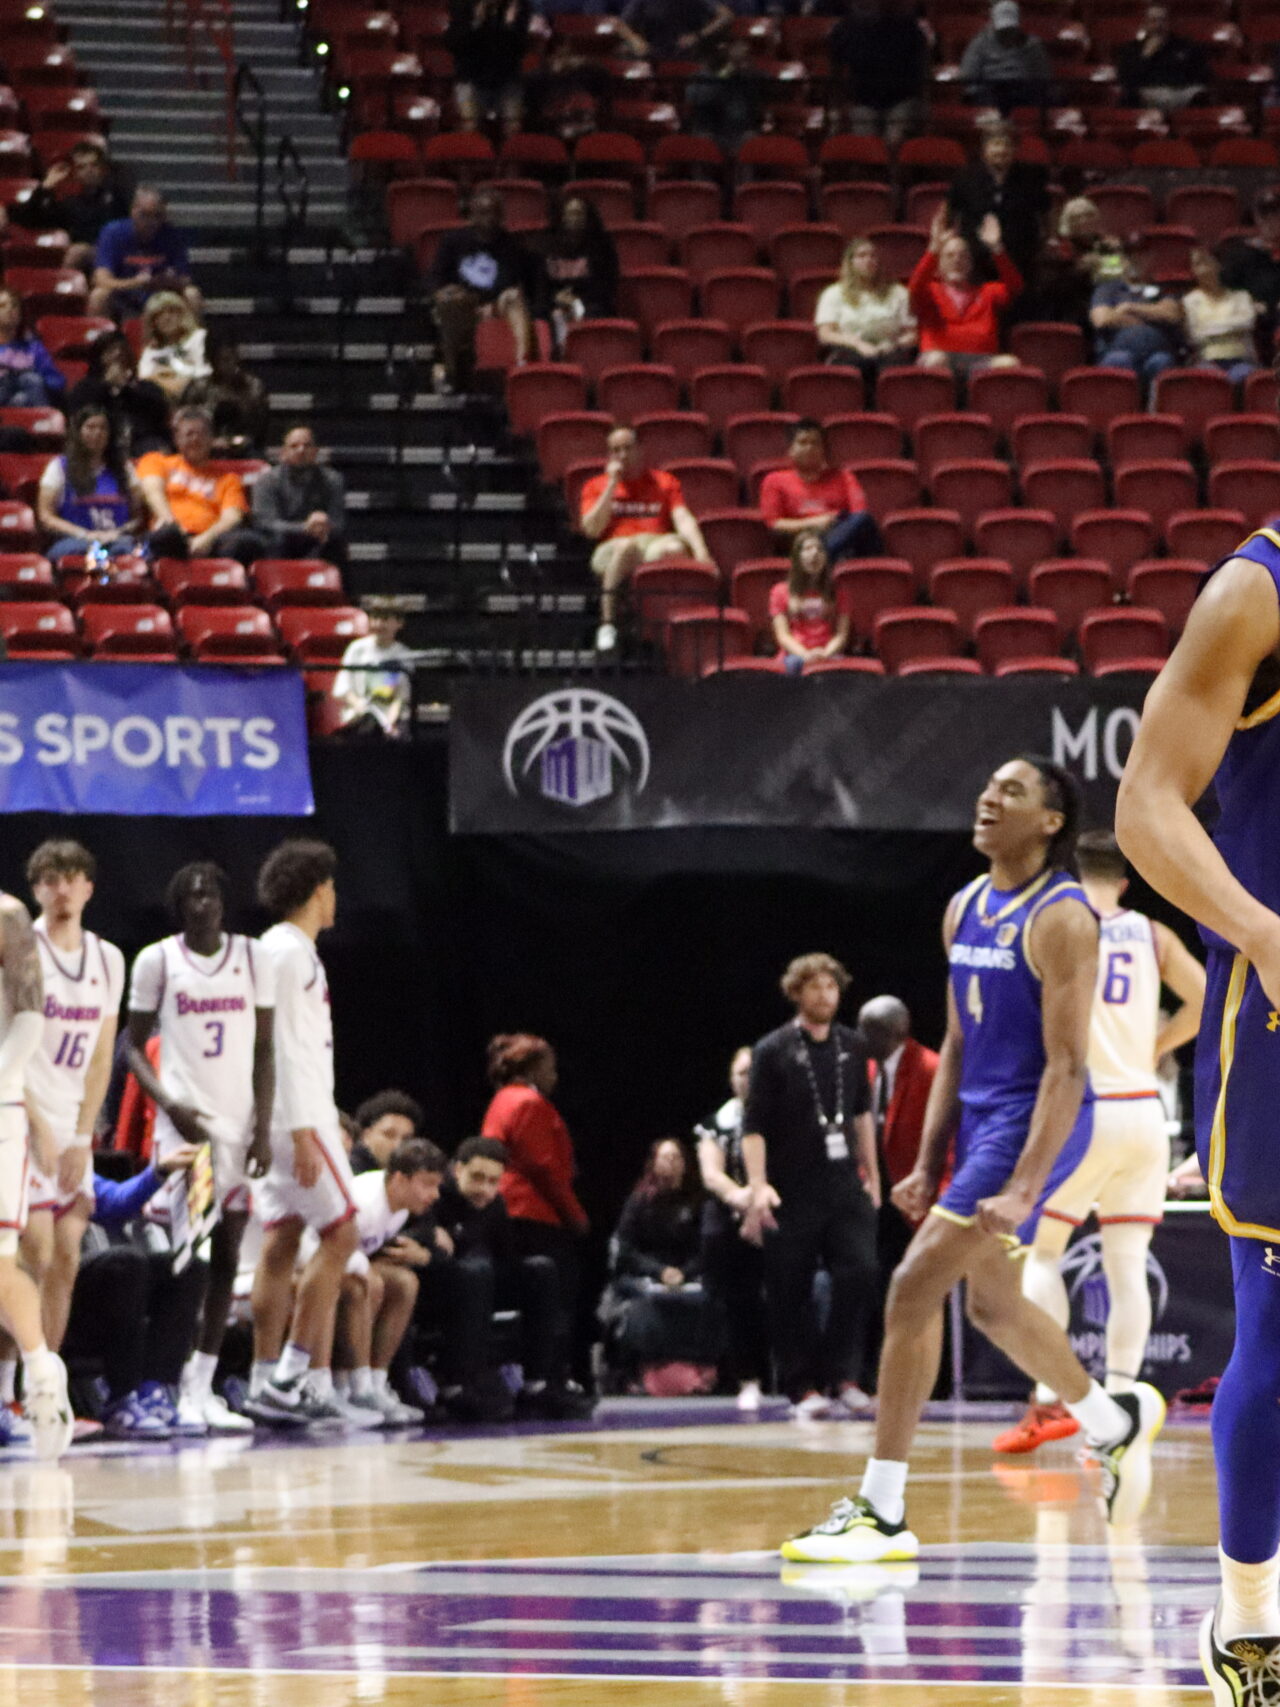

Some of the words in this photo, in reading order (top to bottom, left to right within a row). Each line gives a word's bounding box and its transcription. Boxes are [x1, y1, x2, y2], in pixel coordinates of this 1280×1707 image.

[35, 712, 280, 770] SPORTS
[1102, 951, 1133, 1005] 6
[53, 1031, 90, 1069] 16
[203, 1020, 226, 1058] 3
